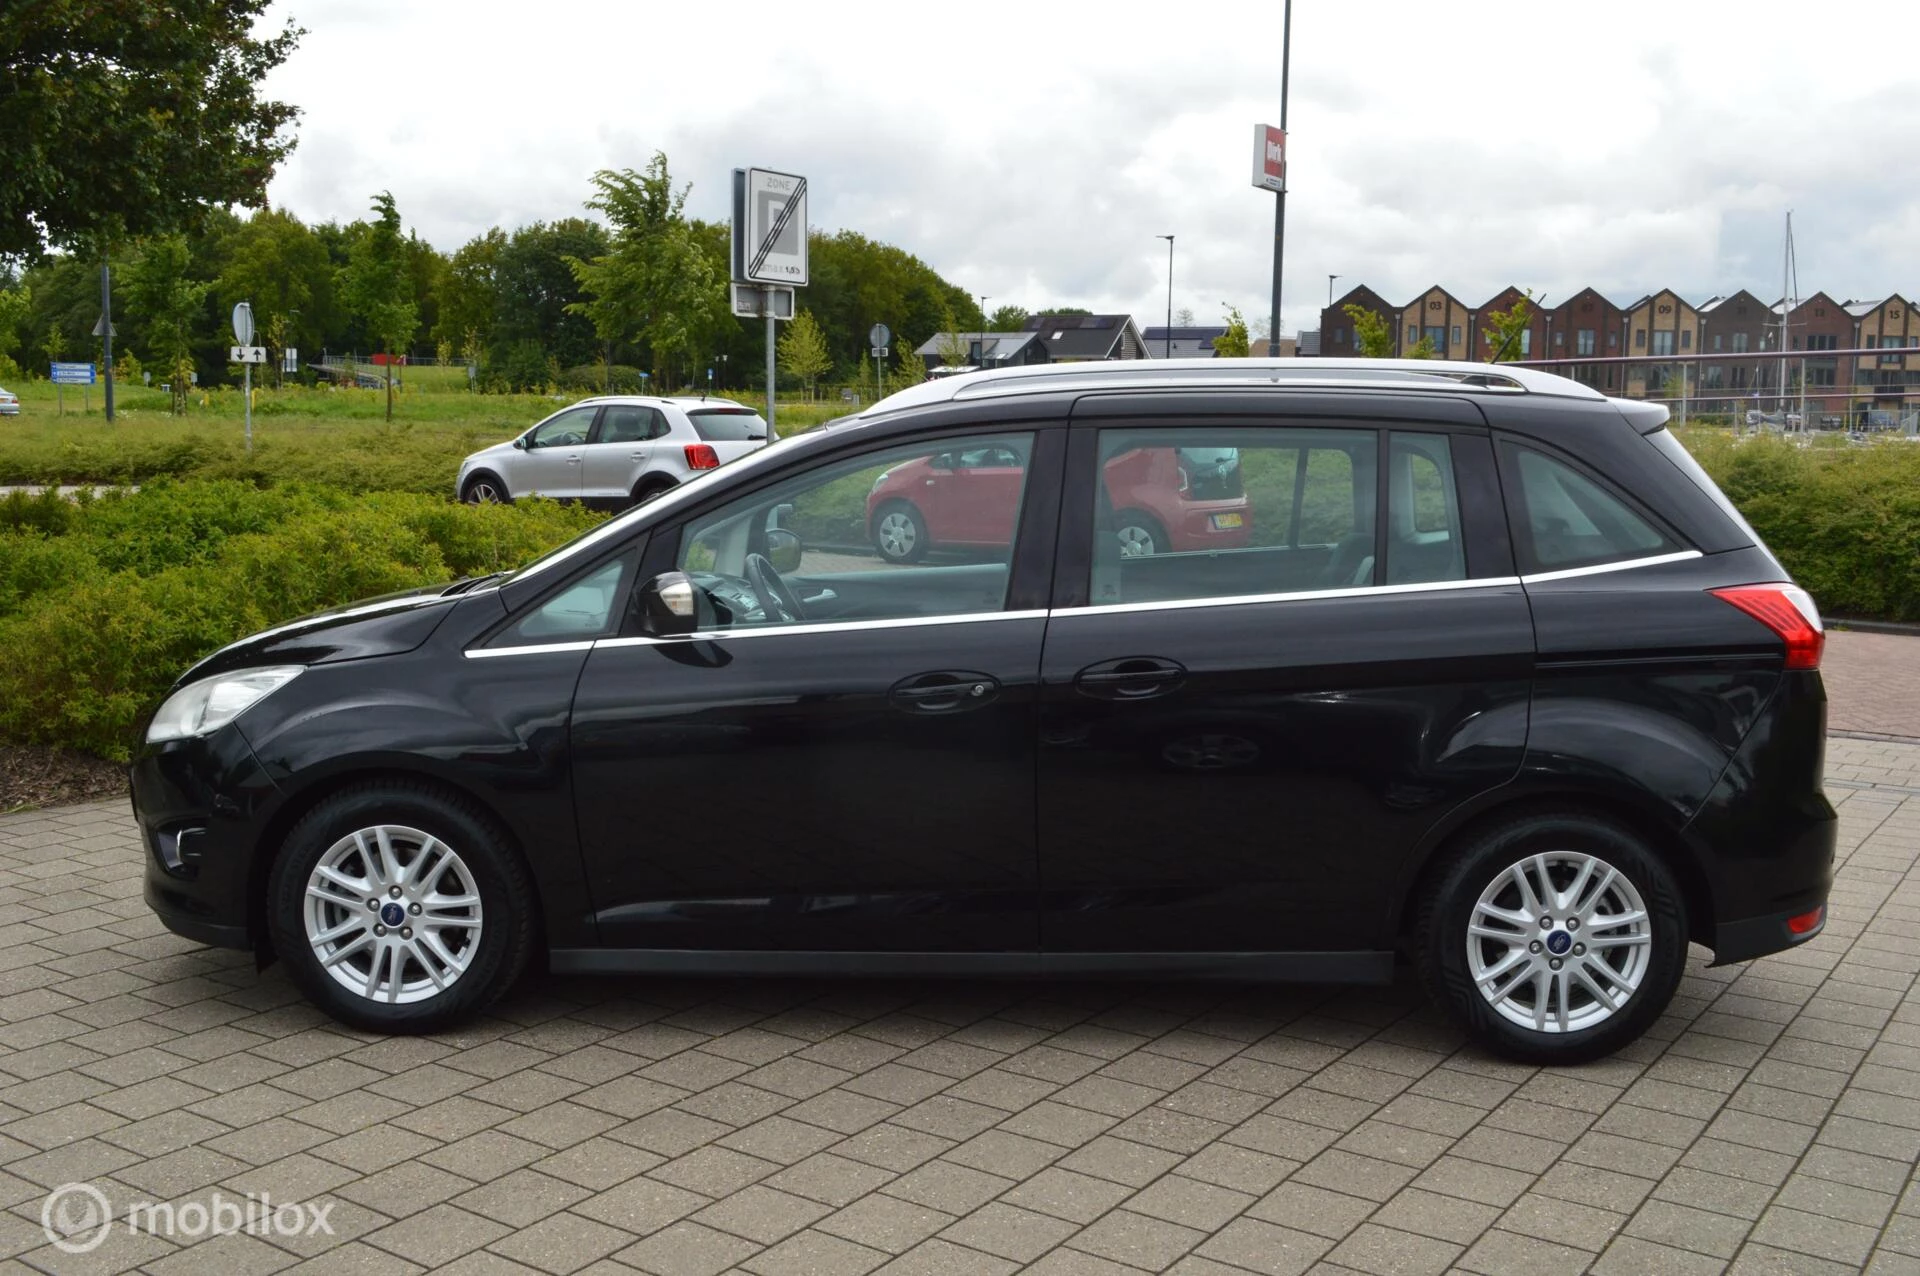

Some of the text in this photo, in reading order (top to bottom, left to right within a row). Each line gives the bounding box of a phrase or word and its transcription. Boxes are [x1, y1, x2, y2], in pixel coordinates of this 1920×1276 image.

[767, 176, 791, 191] ZONE
[1429, 301, 1442, 311] 03
[1658, 304, 1671, 314] 09
[1889, 310, 1900, 320] 15
